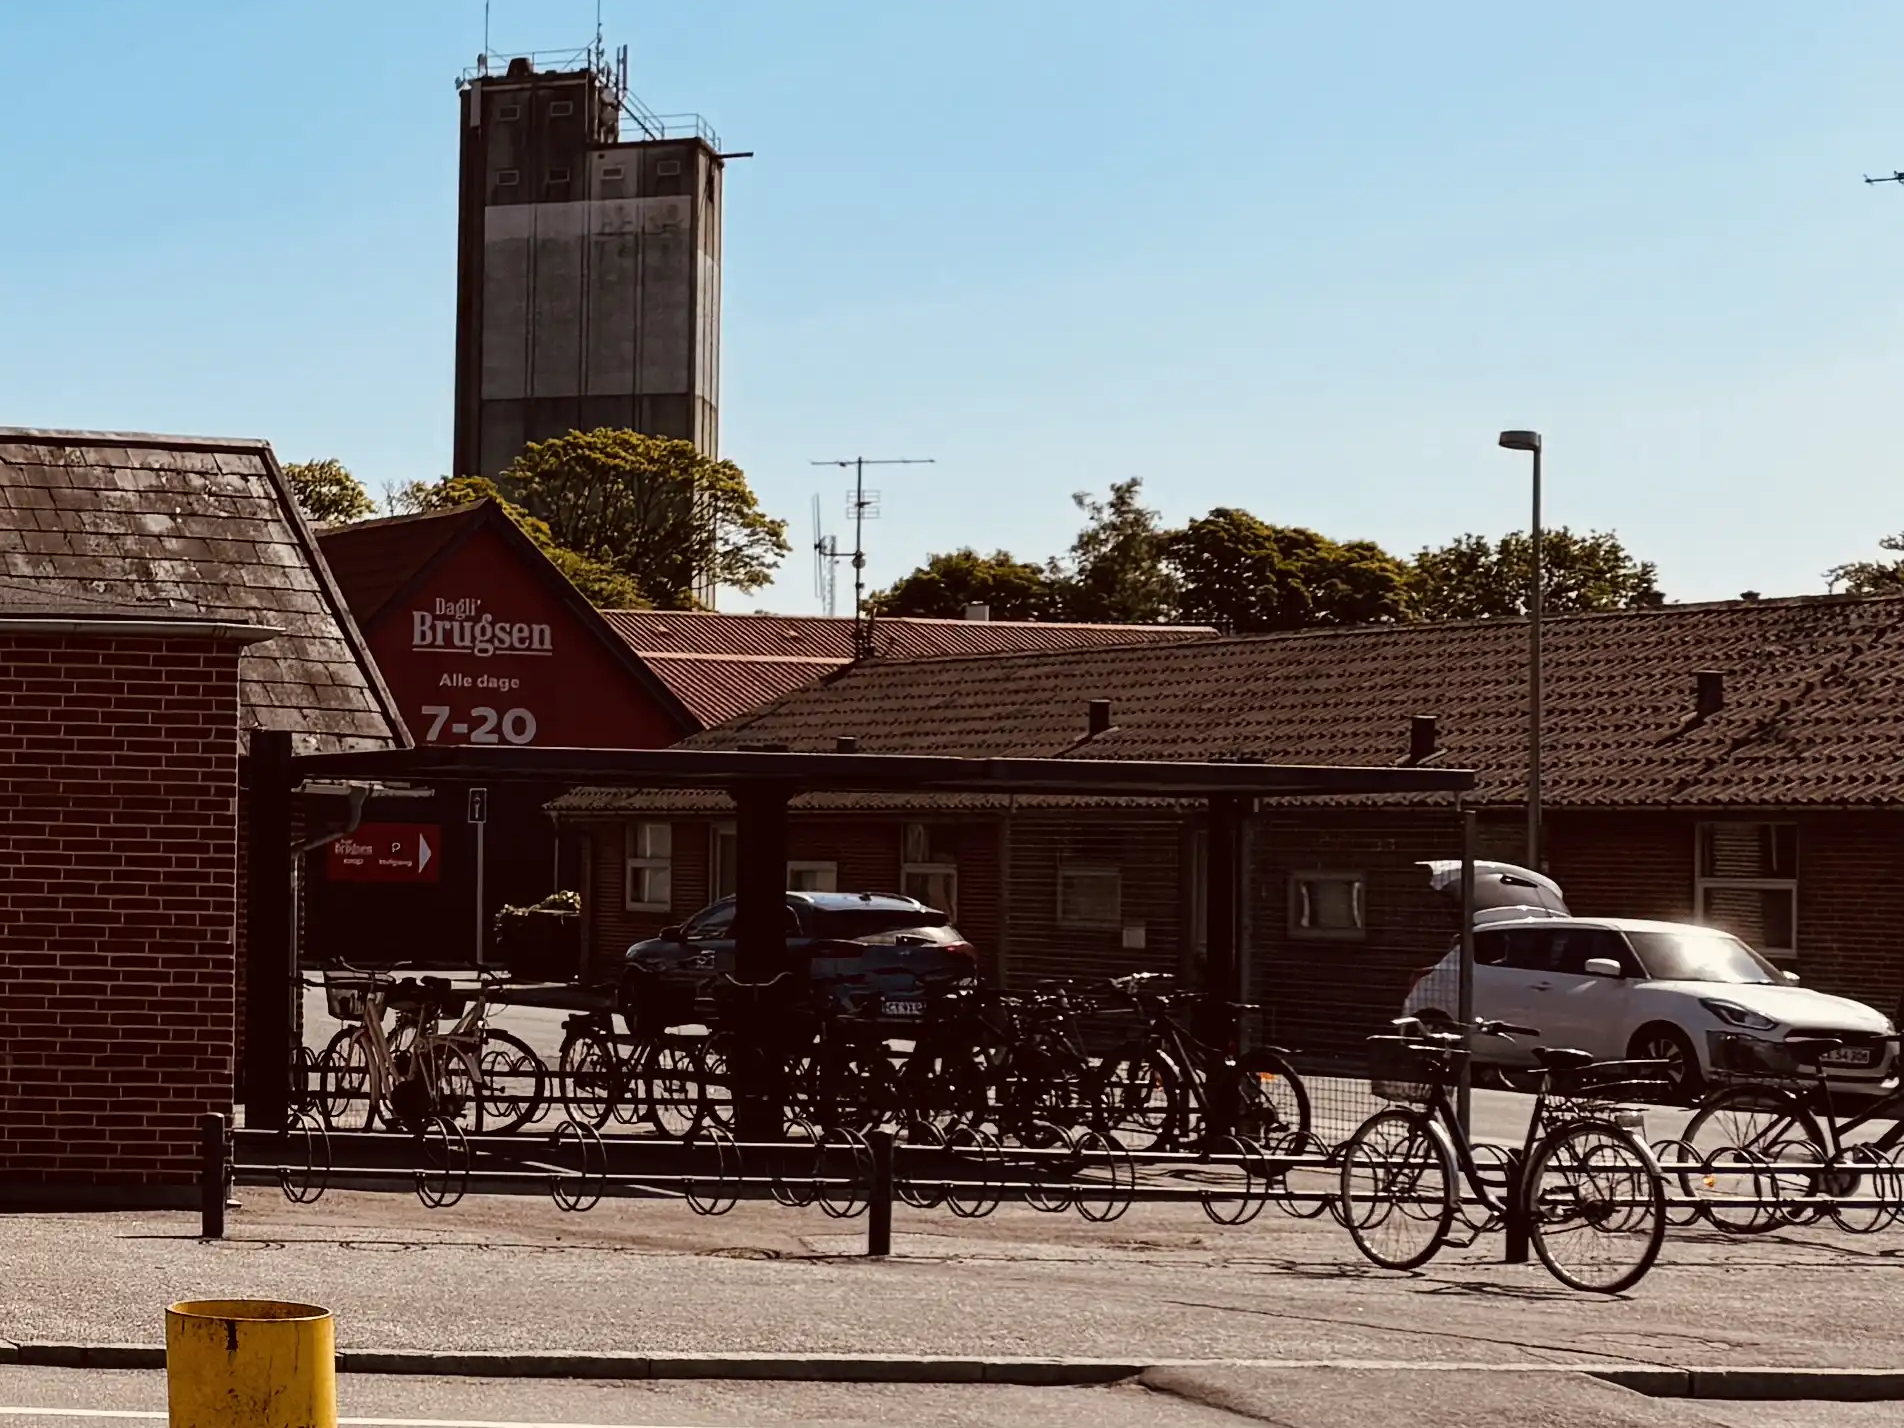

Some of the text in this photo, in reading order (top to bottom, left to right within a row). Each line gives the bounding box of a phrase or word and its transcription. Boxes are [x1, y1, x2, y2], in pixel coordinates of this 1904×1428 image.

[435, 597, 482, 620] Dagli'
[412, 610, 554, 657] Brugsen
[439, 673, 520, 692] Alle dage
[421, 705, 537, 745] 7-20
